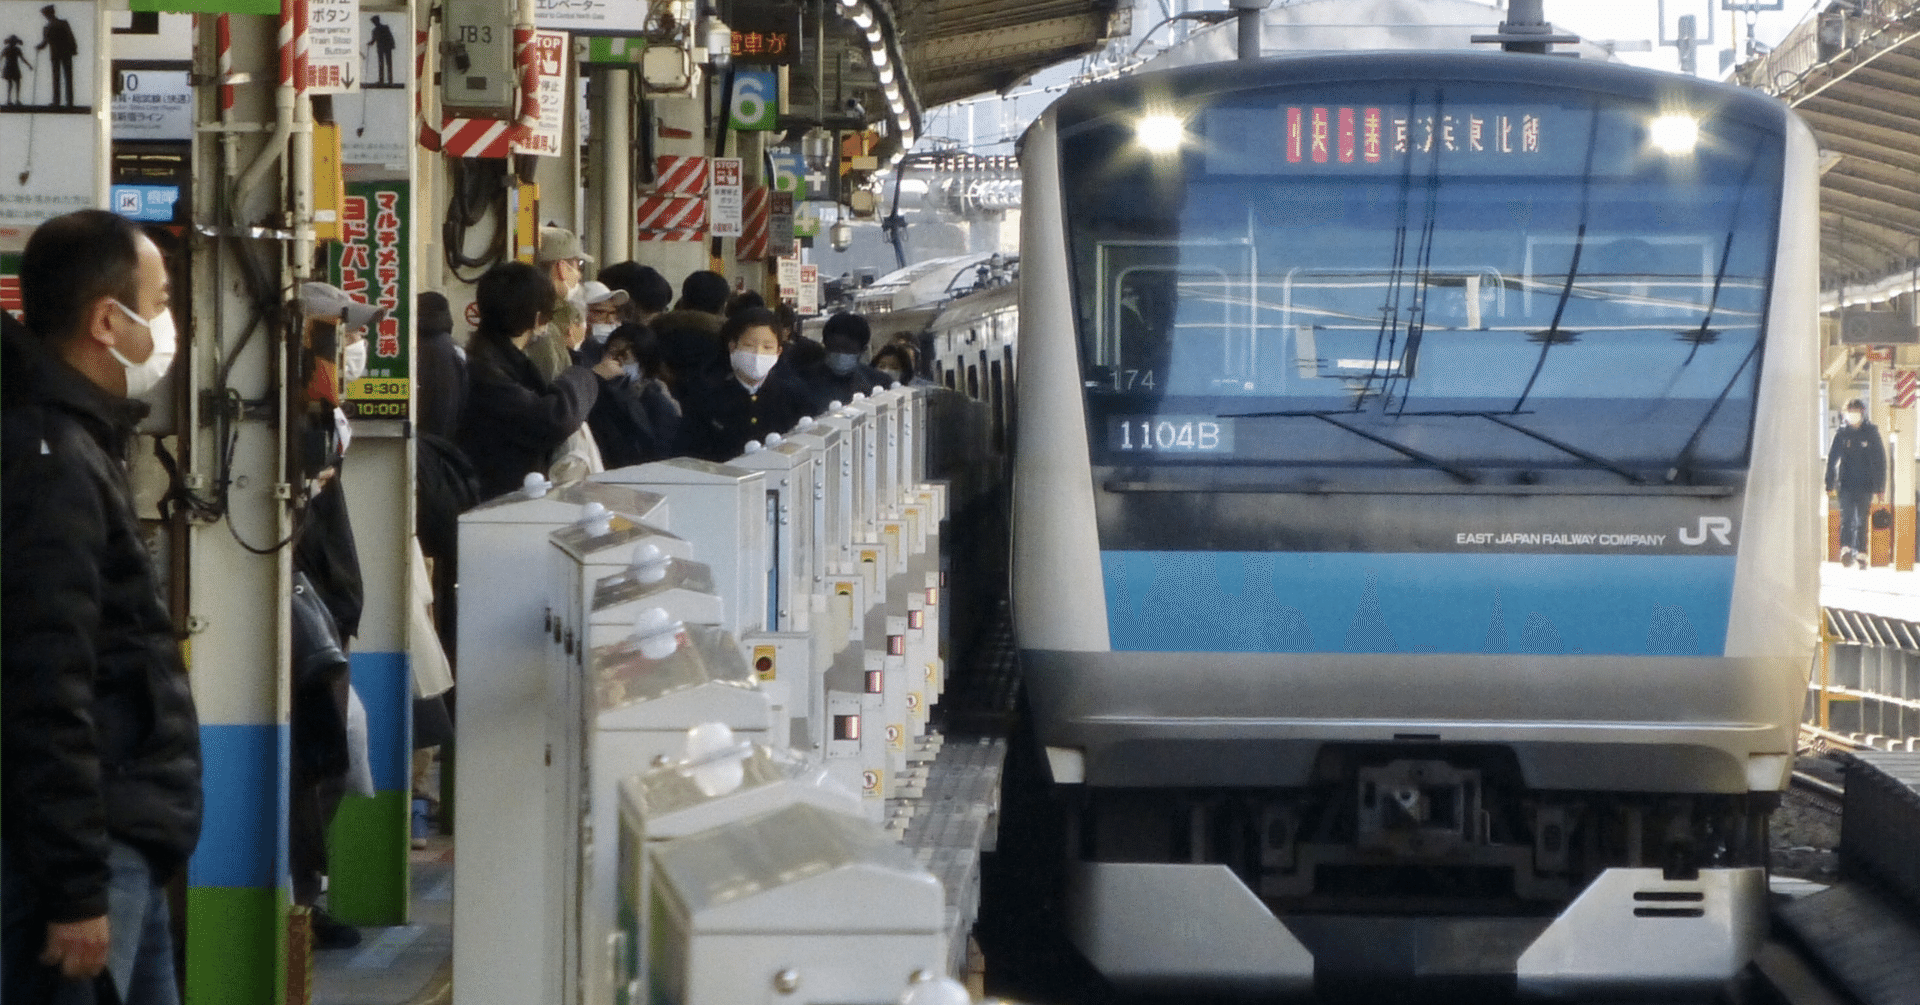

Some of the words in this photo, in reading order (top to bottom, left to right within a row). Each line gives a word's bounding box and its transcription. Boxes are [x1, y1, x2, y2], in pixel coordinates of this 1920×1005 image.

[312, 8, 351, 22] ボタン
[459, 25, 492, 43] JB3
[537, 38, 561, 48] TOP
[730, 76, 765, 125] 6
[773, 158, 798, 192] 5
[794, 200, 815, 232] 4
[363, 382, 400, 395] 9:30
[1110, 369, 1156, 392] 174
[356, 403, 400, 416] 10:00
[1121, 420, 1220, 450] 1104B
[1456, 533, 1494, 544] EAST
[1495, 533, 1540, 545] JAPAN
[1542, 534, 1597, 545] RAILWAY
[1599, 534, 1666, 546] COMPANY
[1679, 516, 1732, 546] JR
